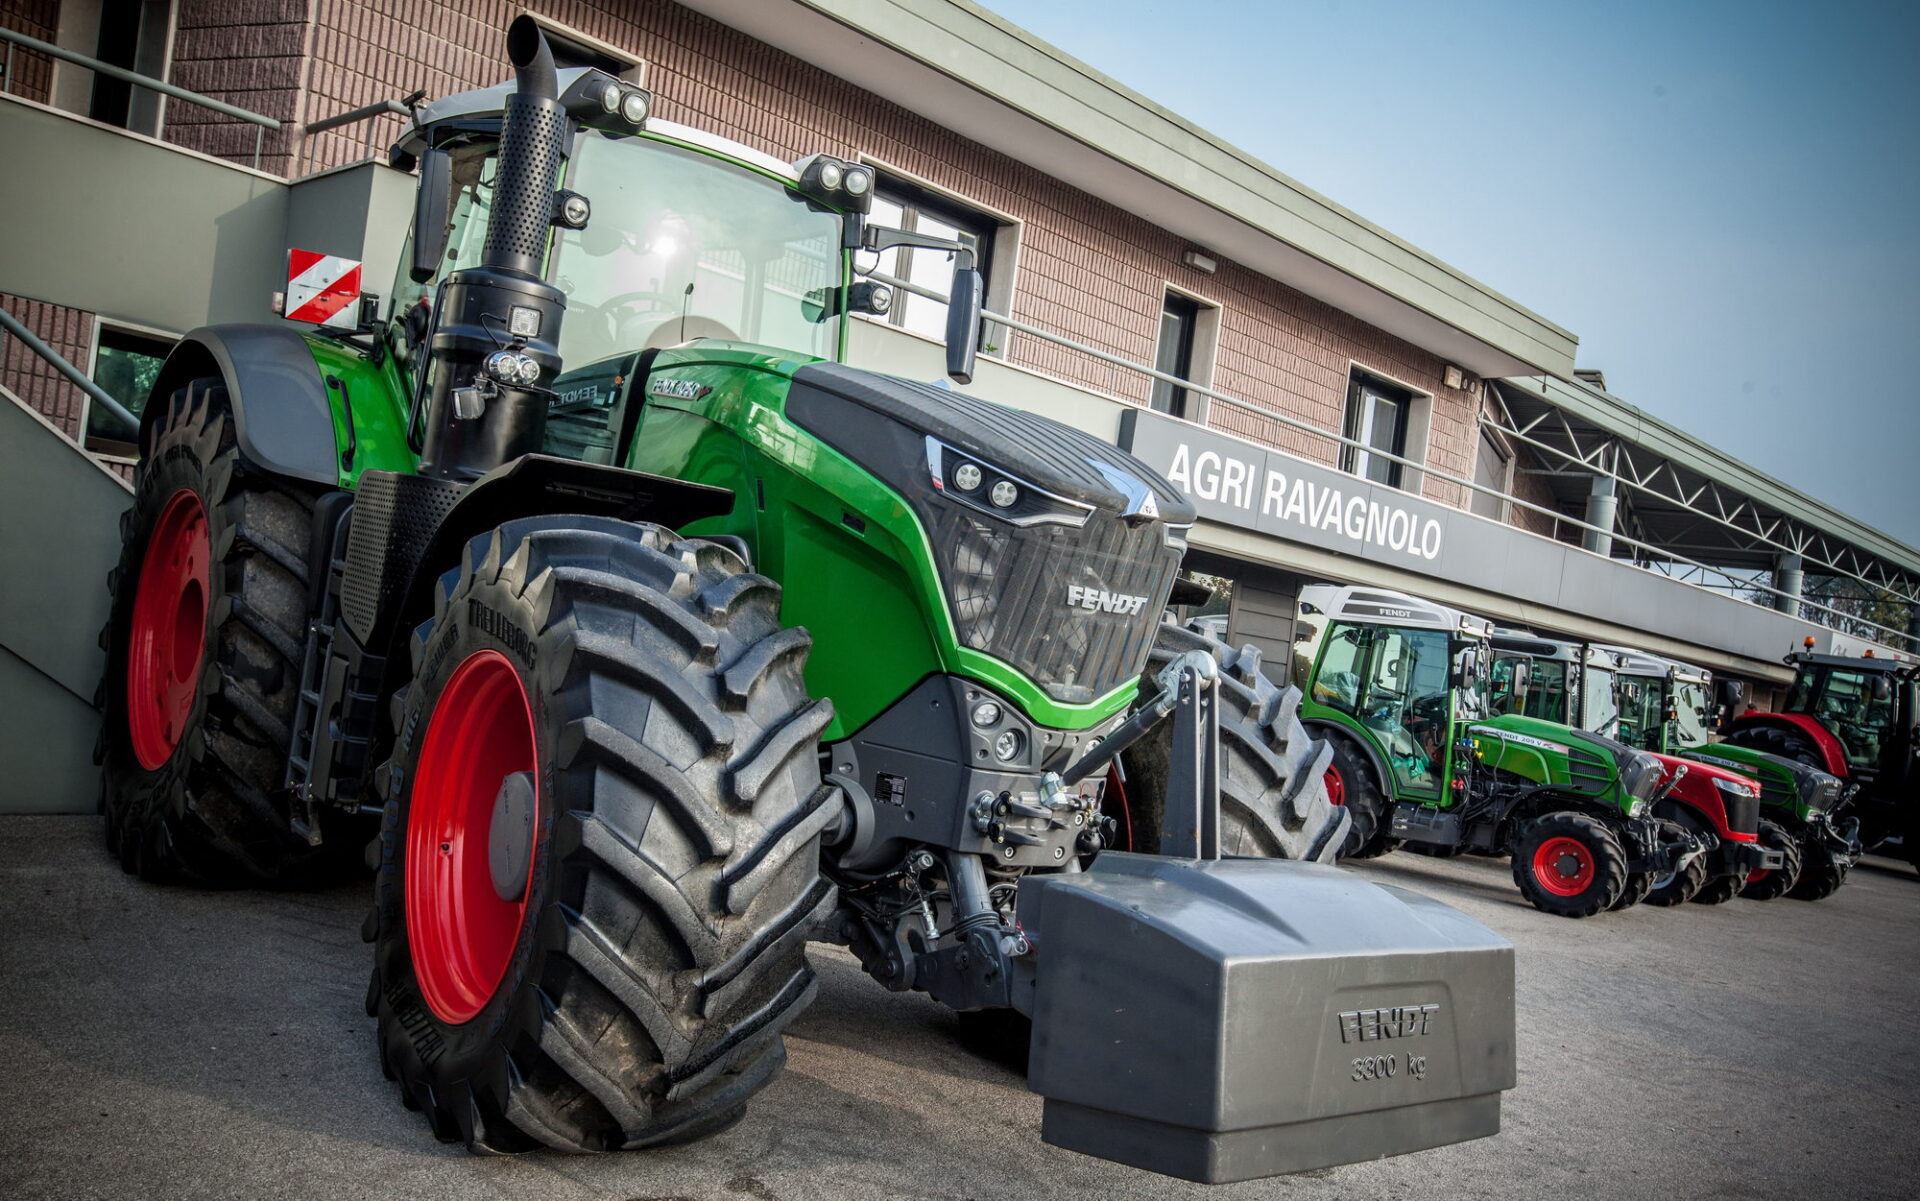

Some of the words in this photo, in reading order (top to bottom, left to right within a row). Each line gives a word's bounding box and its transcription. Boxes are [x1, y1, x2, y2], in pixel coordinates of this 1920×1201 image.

[1168, 444, 1257, 510] AGRI
[1262, 470, 1441, 560] RAVAGNOLO
[1067, 585, 1148, 616] FENDT
[1379, 608, 1411, 617] FENDT
[1521, 736, 1535, 745] 209
[1337, 1004, 1440, 1043] FENDT
[1352, 1054, 1396, 1081] 3300
[1406, 1052, 1426, 1080] kg
